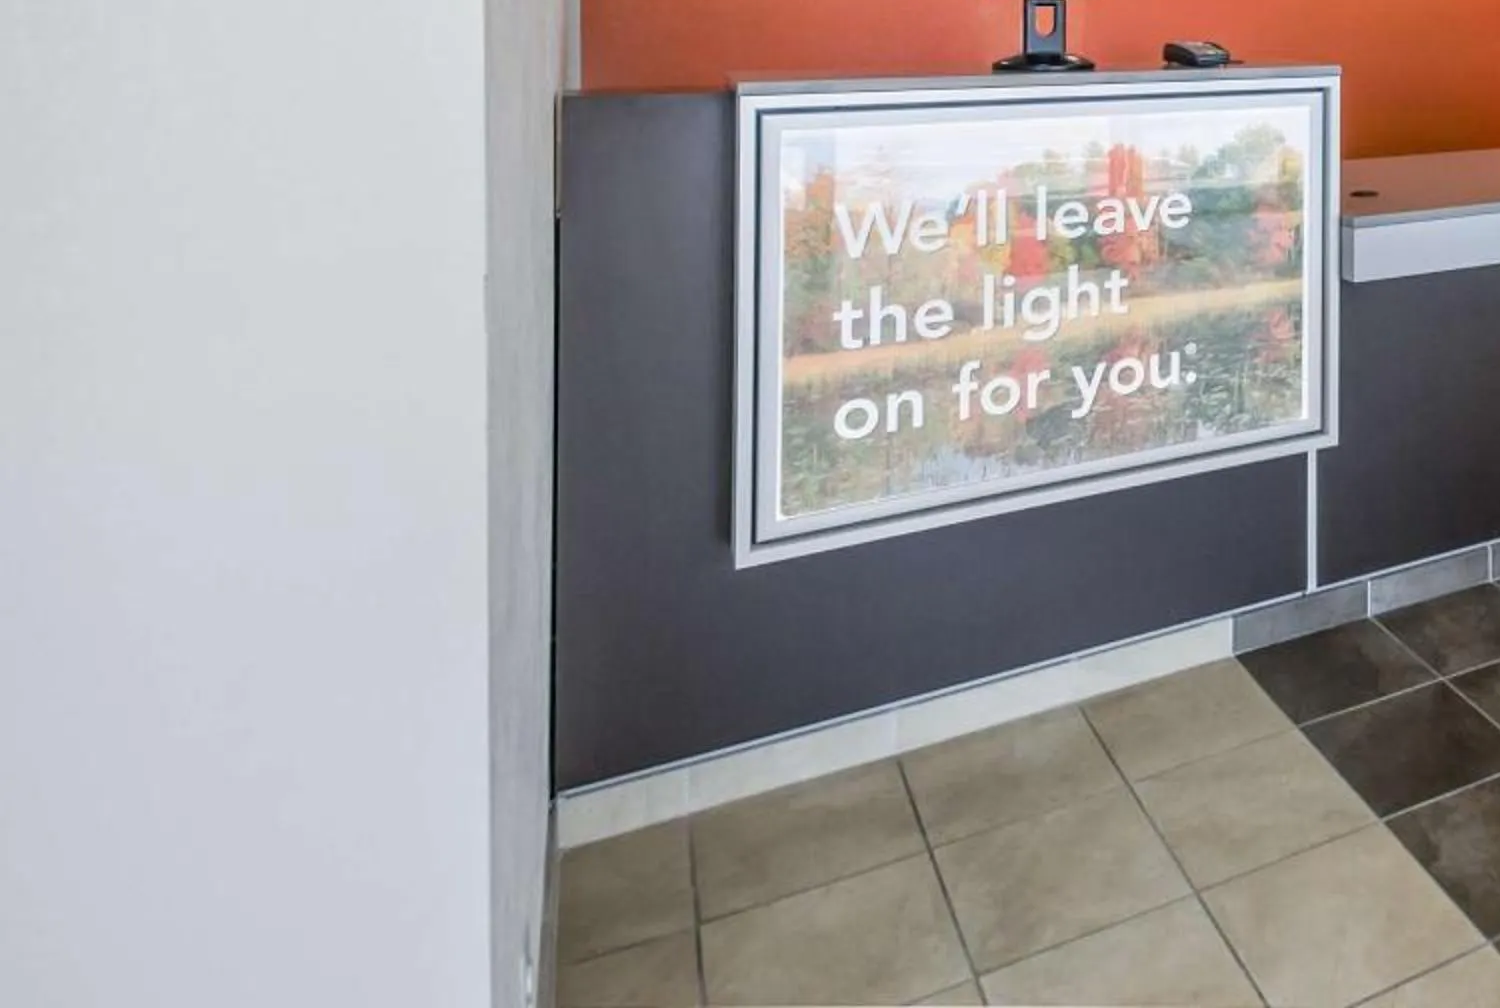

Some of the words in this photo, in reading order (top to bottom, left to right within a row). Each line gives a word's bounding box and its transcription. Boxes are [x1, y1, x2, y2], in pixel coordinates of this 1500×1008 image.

[834, 188, 1008, 260] We'll
[1036, 185, 1194, 242] leave
[833, 285, 955, 351] the
[982, 264, 1130, 342] light
[833, 387, 925, 441] on
[952, 359, 1051, 422] for
